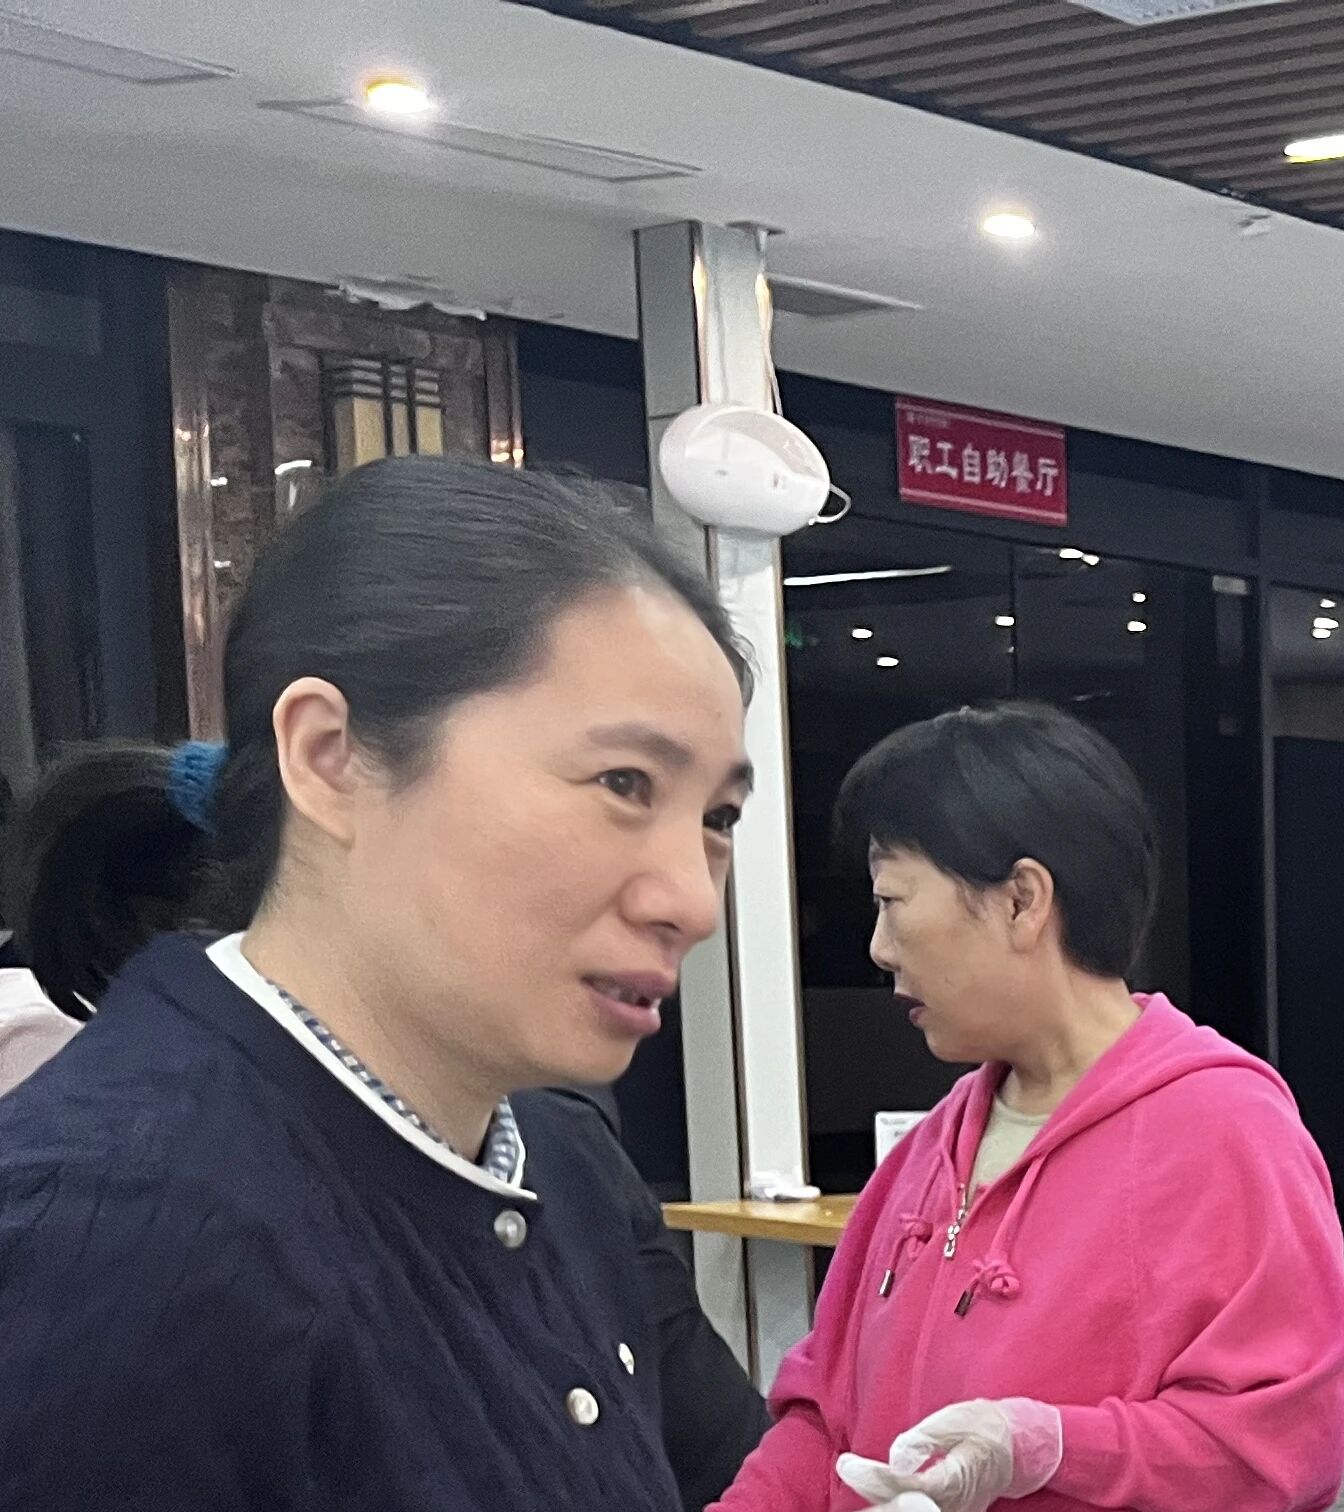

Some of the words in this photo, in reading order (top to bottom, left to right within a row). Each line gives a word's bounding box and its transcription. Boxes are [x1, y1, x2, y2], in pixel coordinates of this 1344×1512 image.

[907, 435, 1059, 496] 职工自助餐厅
